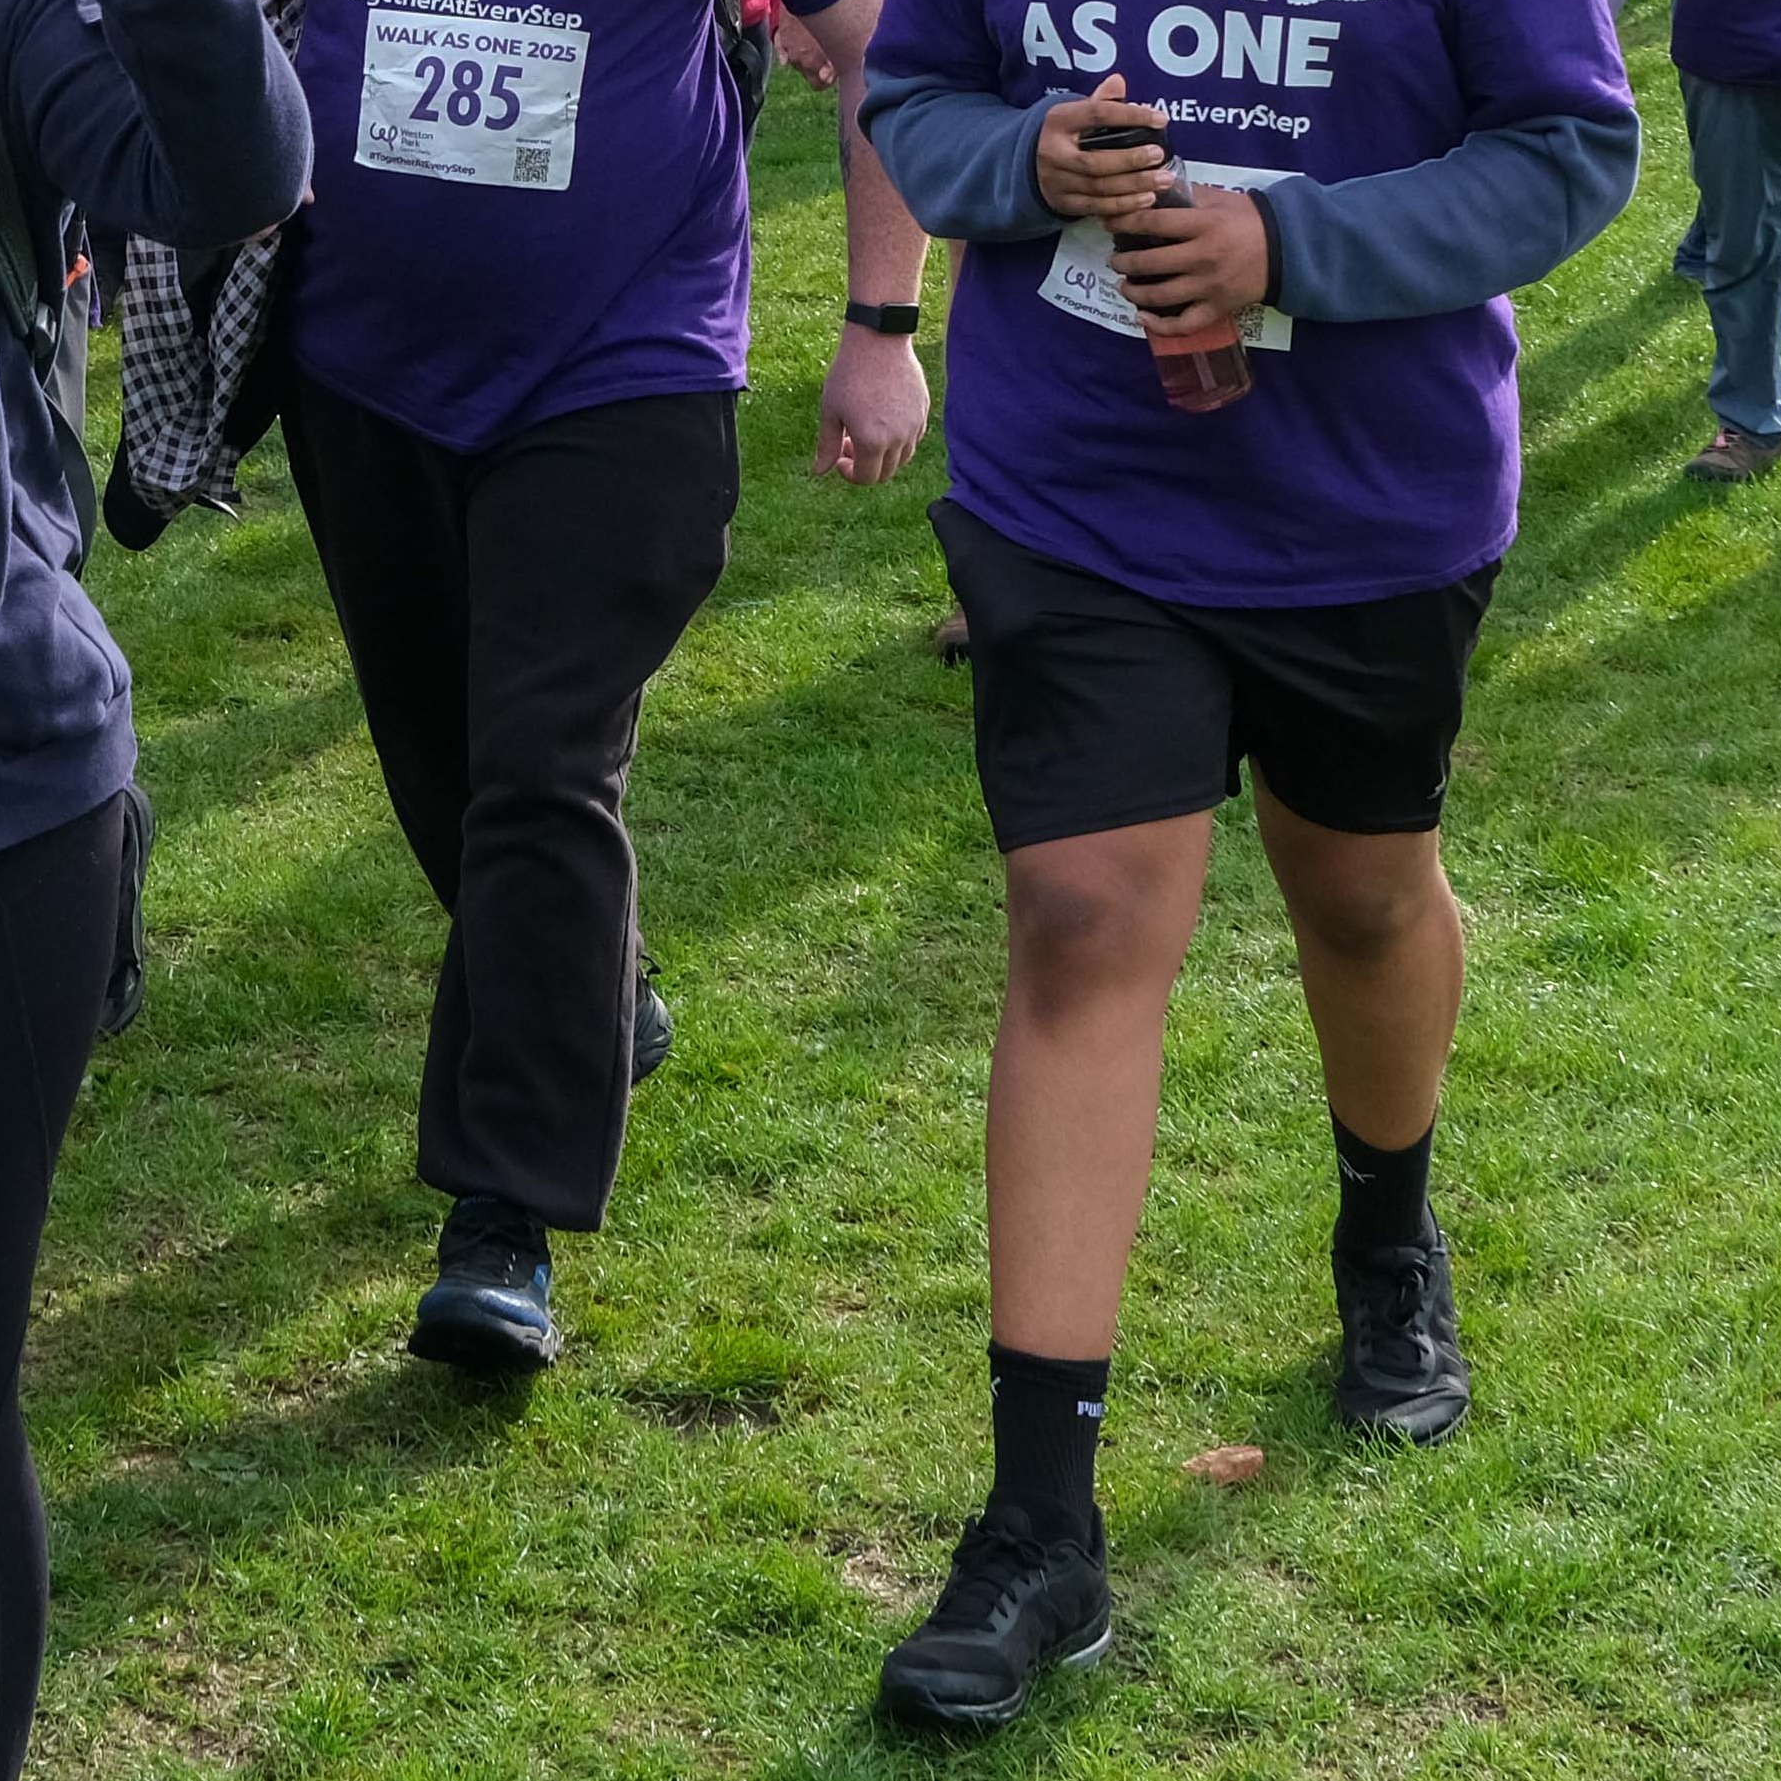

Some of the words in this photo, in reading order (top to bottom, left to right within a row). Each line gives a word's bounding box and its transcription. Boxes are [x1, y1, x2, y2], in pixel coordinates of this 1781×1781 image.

[375, 24, 438, 47] WALK
[440, 31, 470, 50] AS
[474, 35, 524, 57] ONE
[527, 41, 577, 63] 2025
[1022, 0, 1119, 74] AS
[1146, 3, 1342, 89] ONE
[408, 55, 524, 132] 285
[400, 126, 434, 141] Weston
[400, 137, 421, 148] Park
[369, 151, 476, 177] #TogetherAtEveryStep
